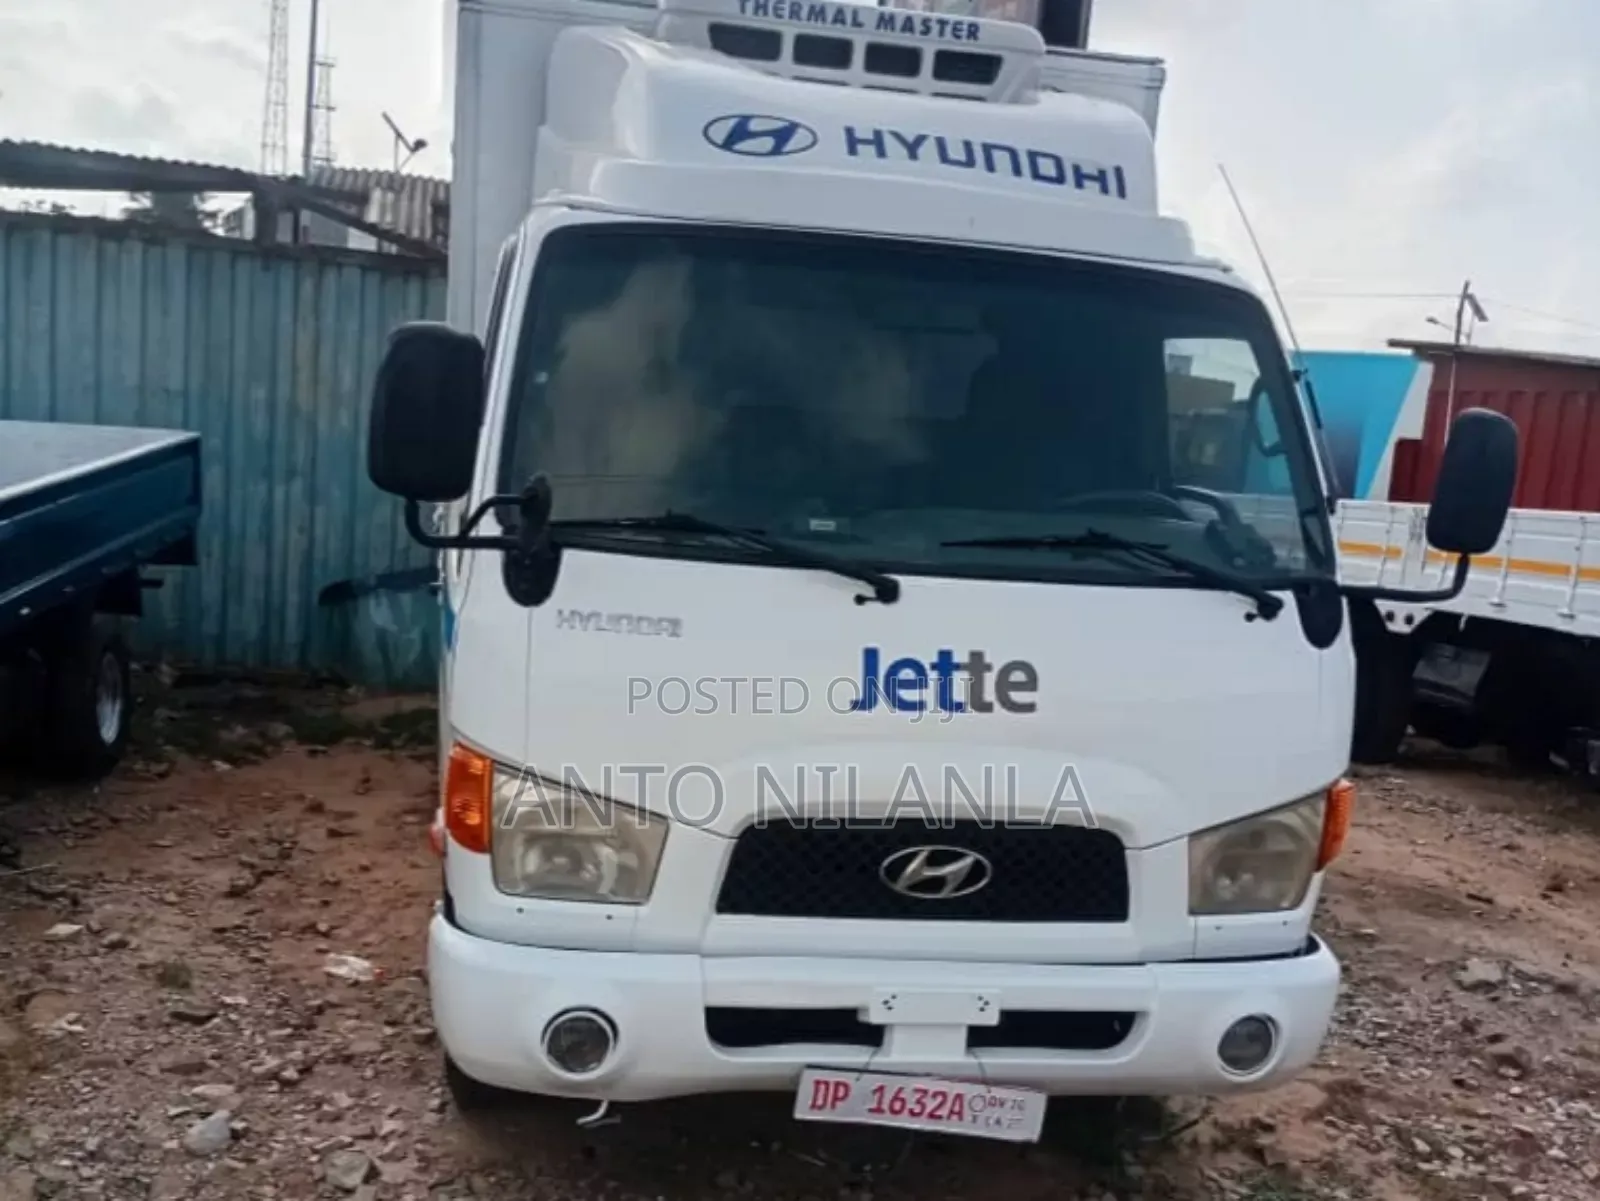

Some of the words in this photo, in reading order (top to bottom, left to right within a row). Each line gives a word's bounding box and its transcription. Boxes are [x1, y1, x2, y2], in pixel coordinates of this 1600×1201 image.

[738, 0, 865, 28] THERMAL
[875, 12, 981, 42] MASTER
[850, 646, 1038, 713] Jette
[809, 1079, 851, 1110] DP
[868, 1084, 964, 1121] 1632A
